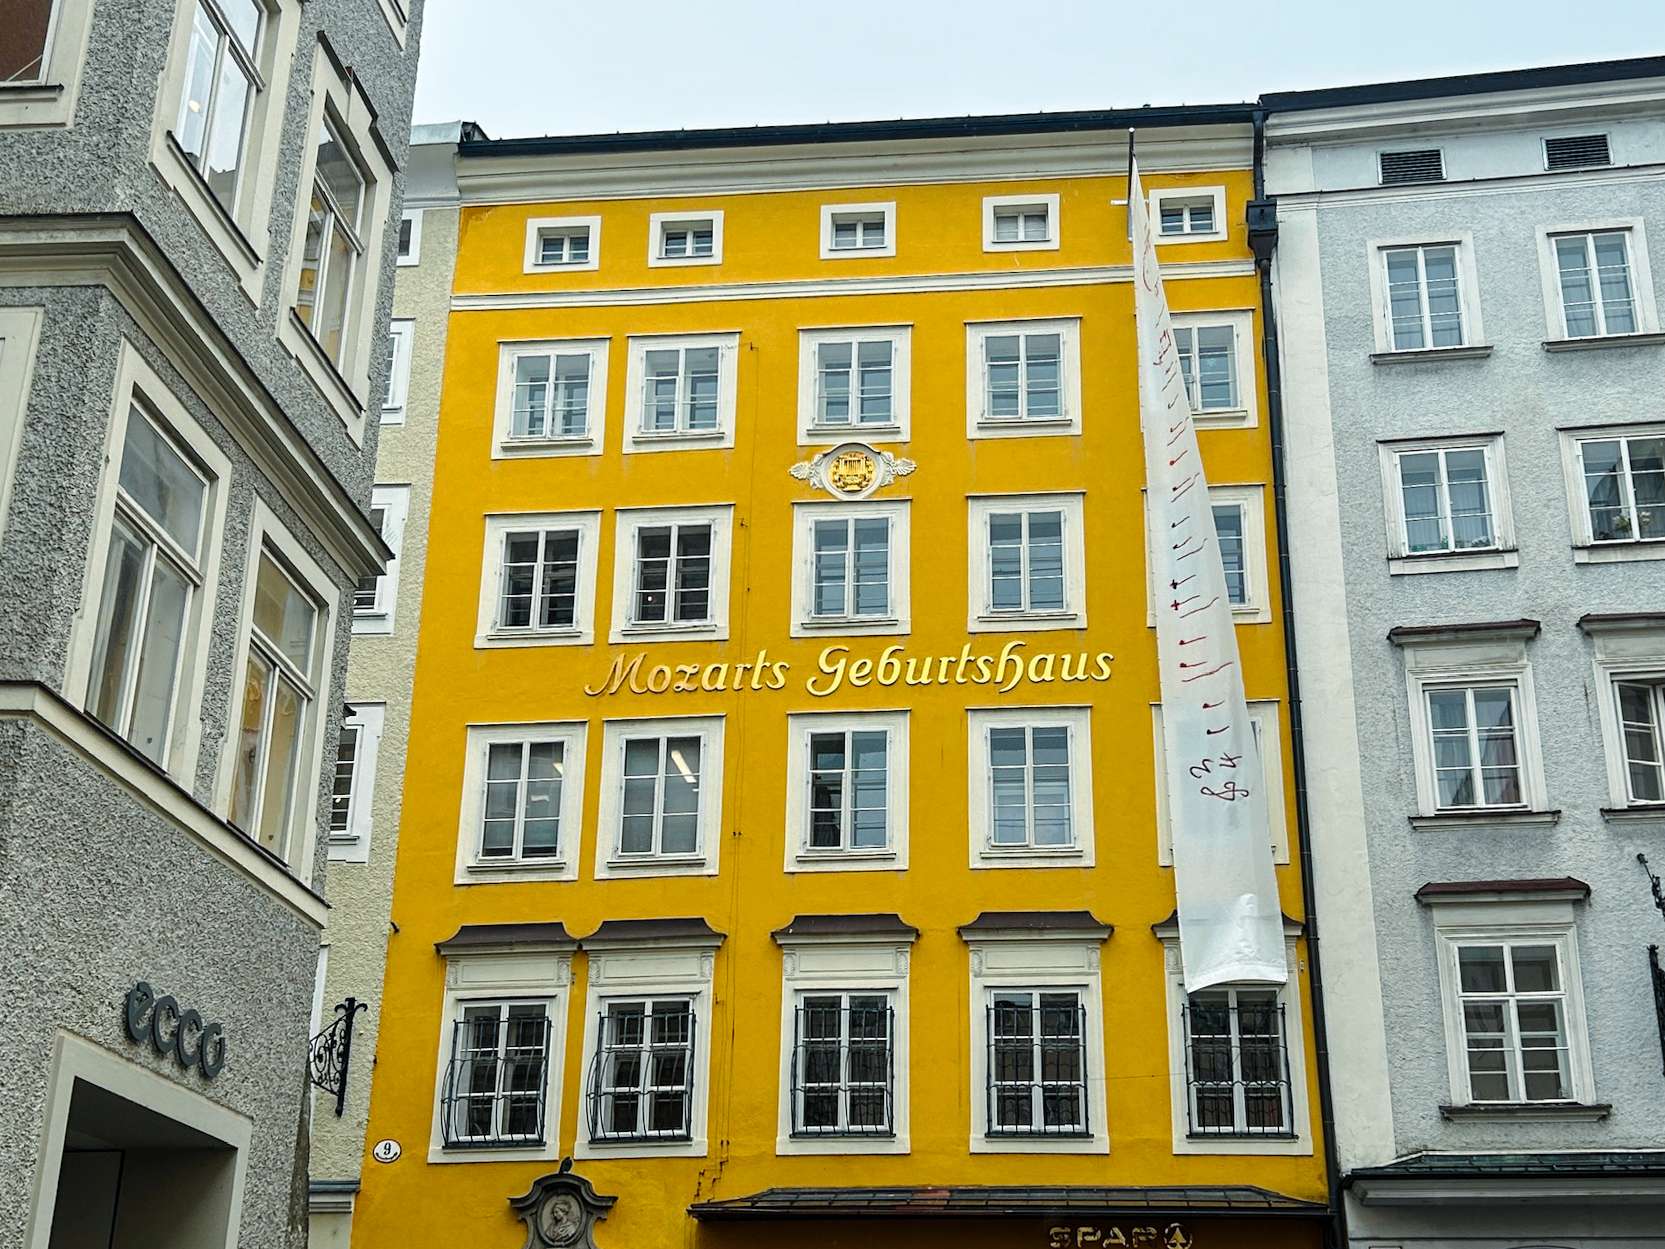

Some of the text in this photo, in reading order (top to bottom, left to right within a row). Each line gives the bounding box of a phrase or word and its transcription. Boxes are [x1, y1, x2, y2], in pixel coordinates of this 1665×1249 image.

[584, 640, 1115, 697] Mozarts Geburtshaus
[126, 981, 225, 1078] ecco
[1049, 1226, 1158, 1248] SPAR
